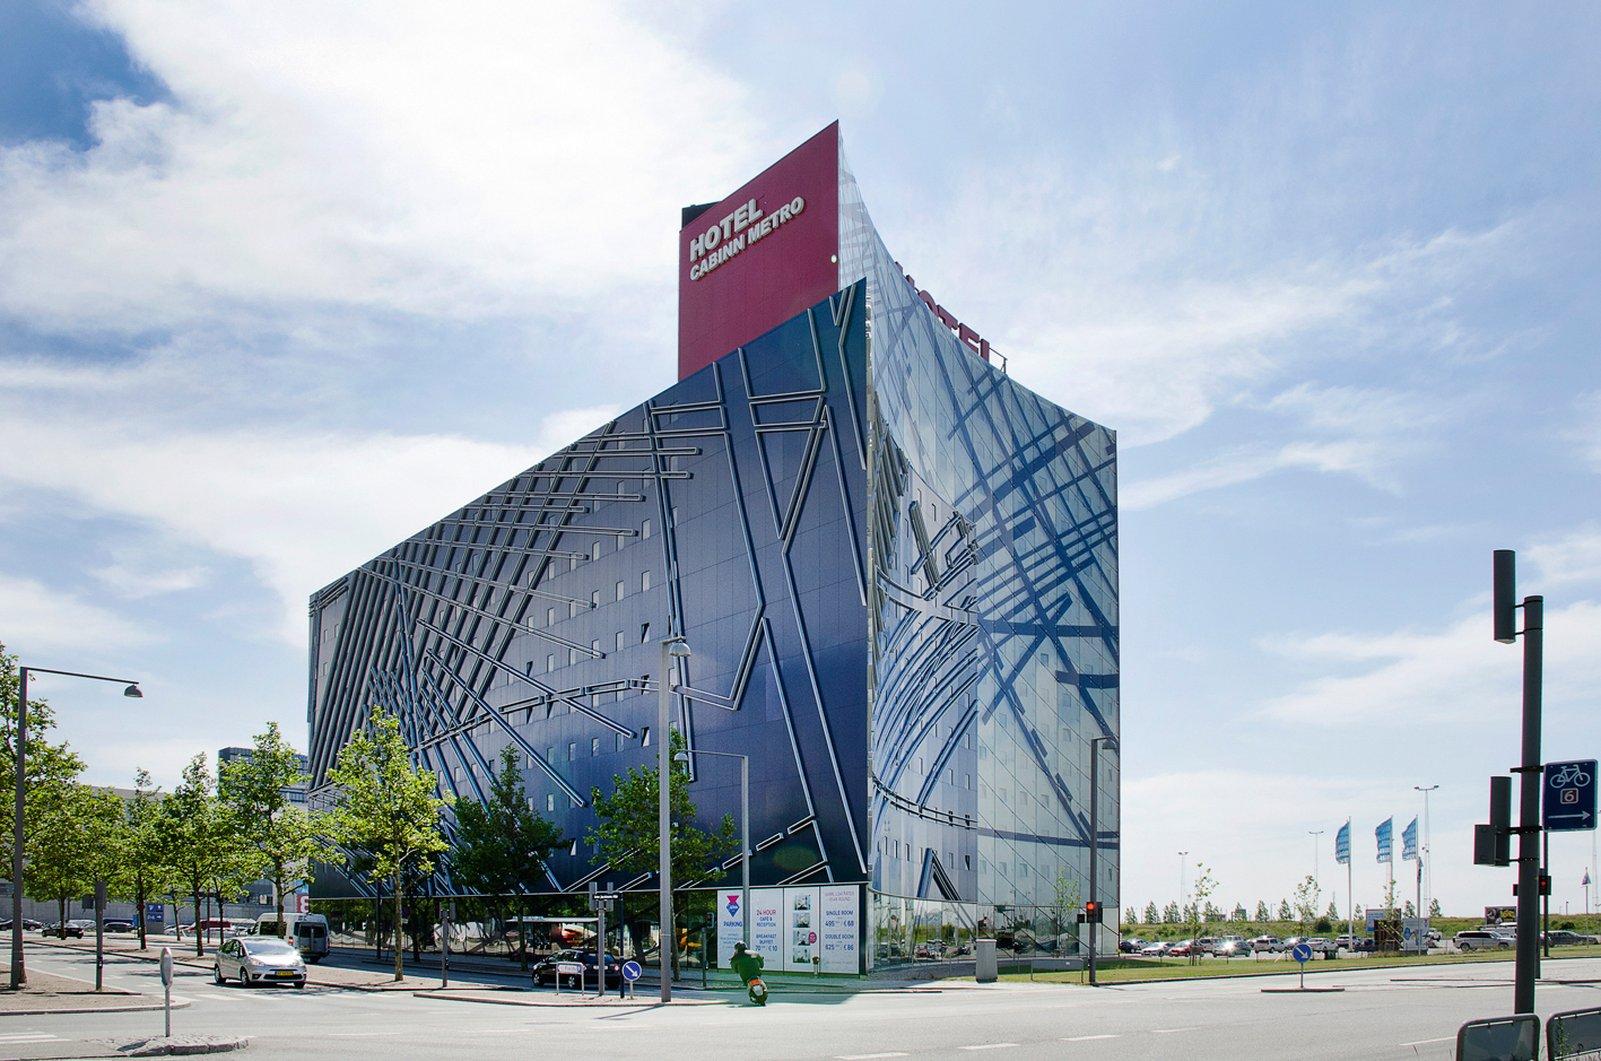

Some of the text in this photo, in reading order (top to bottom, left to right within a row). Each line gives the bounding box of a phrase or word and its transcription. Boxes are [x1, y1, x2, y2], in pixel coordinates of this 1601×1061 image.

[690, 198, 763, 262] HOTEL
[690, 196, 805, 281] CABINN METRO
[1564, 789, 1575, 803] 6
